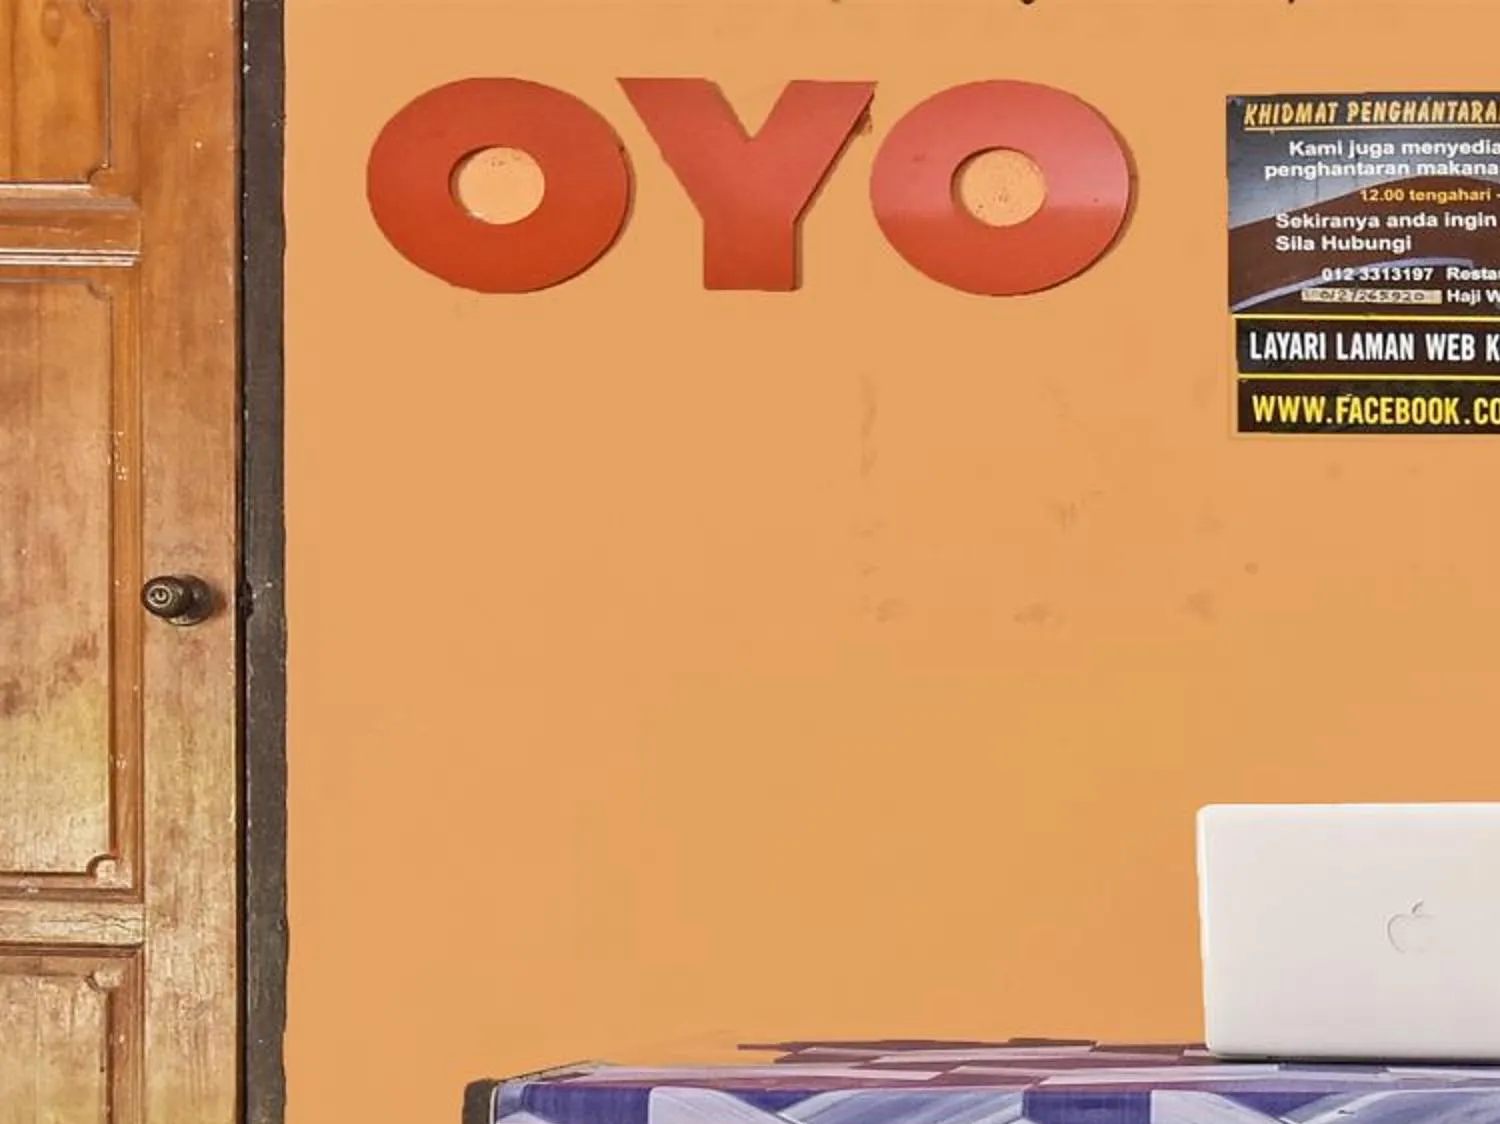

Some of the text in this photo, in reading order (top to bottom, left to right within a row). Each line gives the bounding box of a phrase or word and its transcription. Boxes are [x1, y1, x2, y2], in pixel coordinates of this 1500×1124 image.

[1244, 102, 1339, 126] KHIDMAT
[1289, 139, 1342, 156] Kami
[1348, 139, 1394, 160] juga
[1264, 161, 1409, 181] penghantaran
[366, 76, 1137, 296] OYO
[1360, 188, 1404, 202] 12.00
[1409, 187, 1491, 204] tengahari
[1275, 212, 1380, 231] Sekiranya
[1386, 212, 1438, 228] anda
[1445, 212, 1497, 230] ingin
[1275, 235, 1412, 254] Sila Hubungi
[1321, 267, 1354, 281] 012
[1359, 267, 1434, 281] 3313197
[1447, 289, 1480, 306] Haji
[1250, 331, 1327, 361] LAYARI
[1336, 332, 1415, 361] LAMAN
[1425, 332, 1475, 361] WEB
